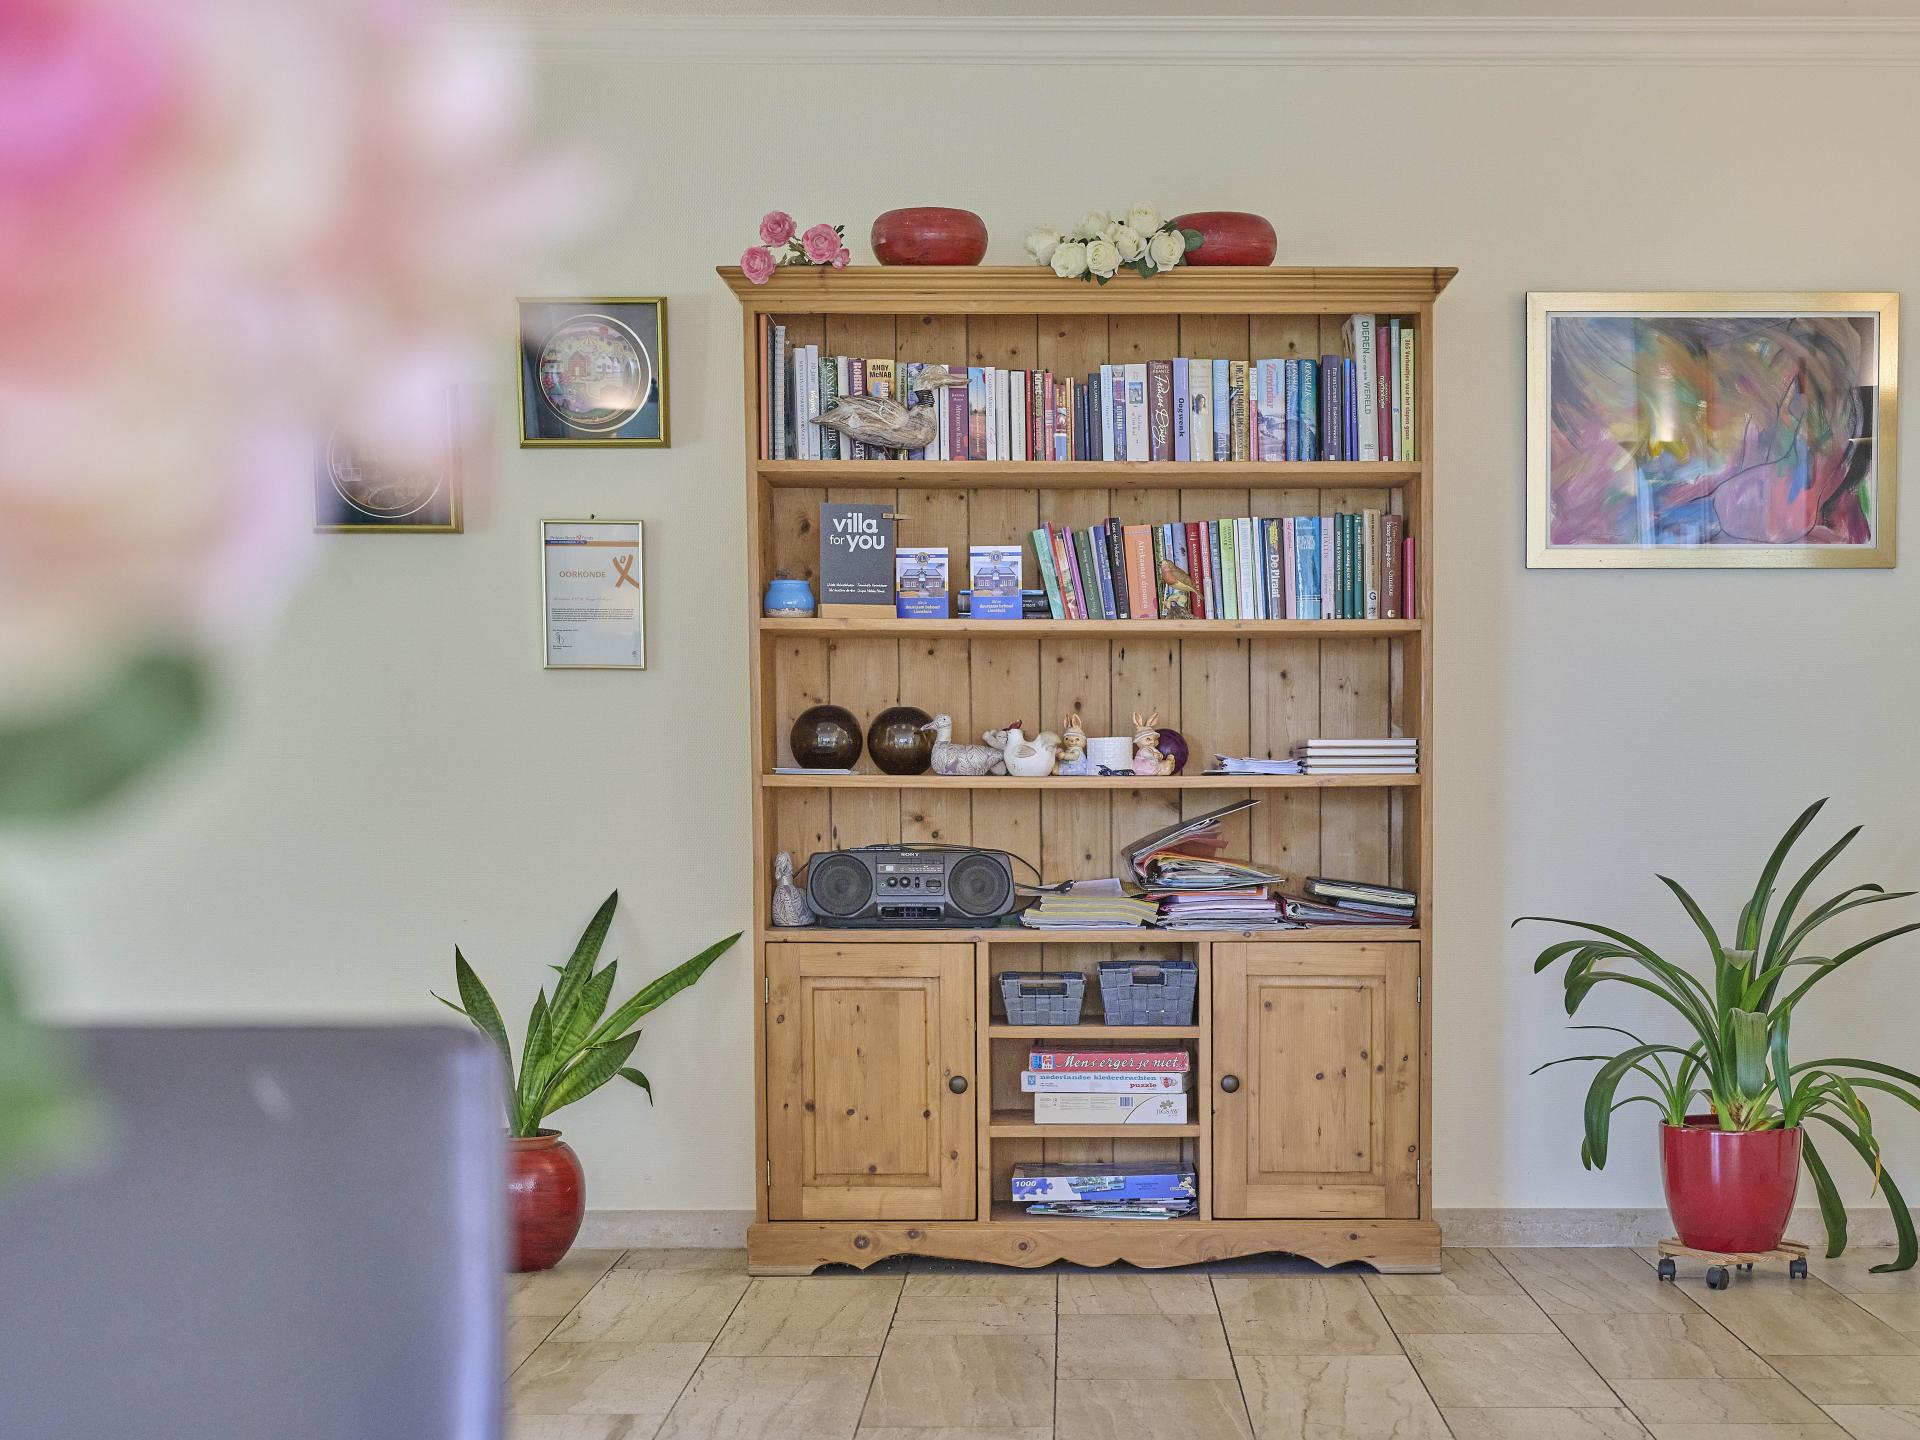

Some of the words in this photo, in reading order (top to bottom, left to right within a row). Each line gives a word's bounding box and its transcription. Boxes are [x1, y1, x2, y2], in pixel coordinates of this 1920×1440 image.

[1362, 321, 1370, 354] DIEREN
[1035, 373, 1043, 394] Kirst
[1265, 364, 1277, 408] Zemindar
[1177, 398, 1185, 437] Oogwenk
[833, 513, 878, 533] villa
[830, 534, 845, 544] for
[846, 535, 885, 552] you
[1271, 554, 1280, 569] De
[1271, 569, 1280, 598] Piraat
[1062, 1055, 1096, 1067] Mens
[1100, 1056, 1134, 1069] erger
[1136, 1056, 1149, 1069] je
